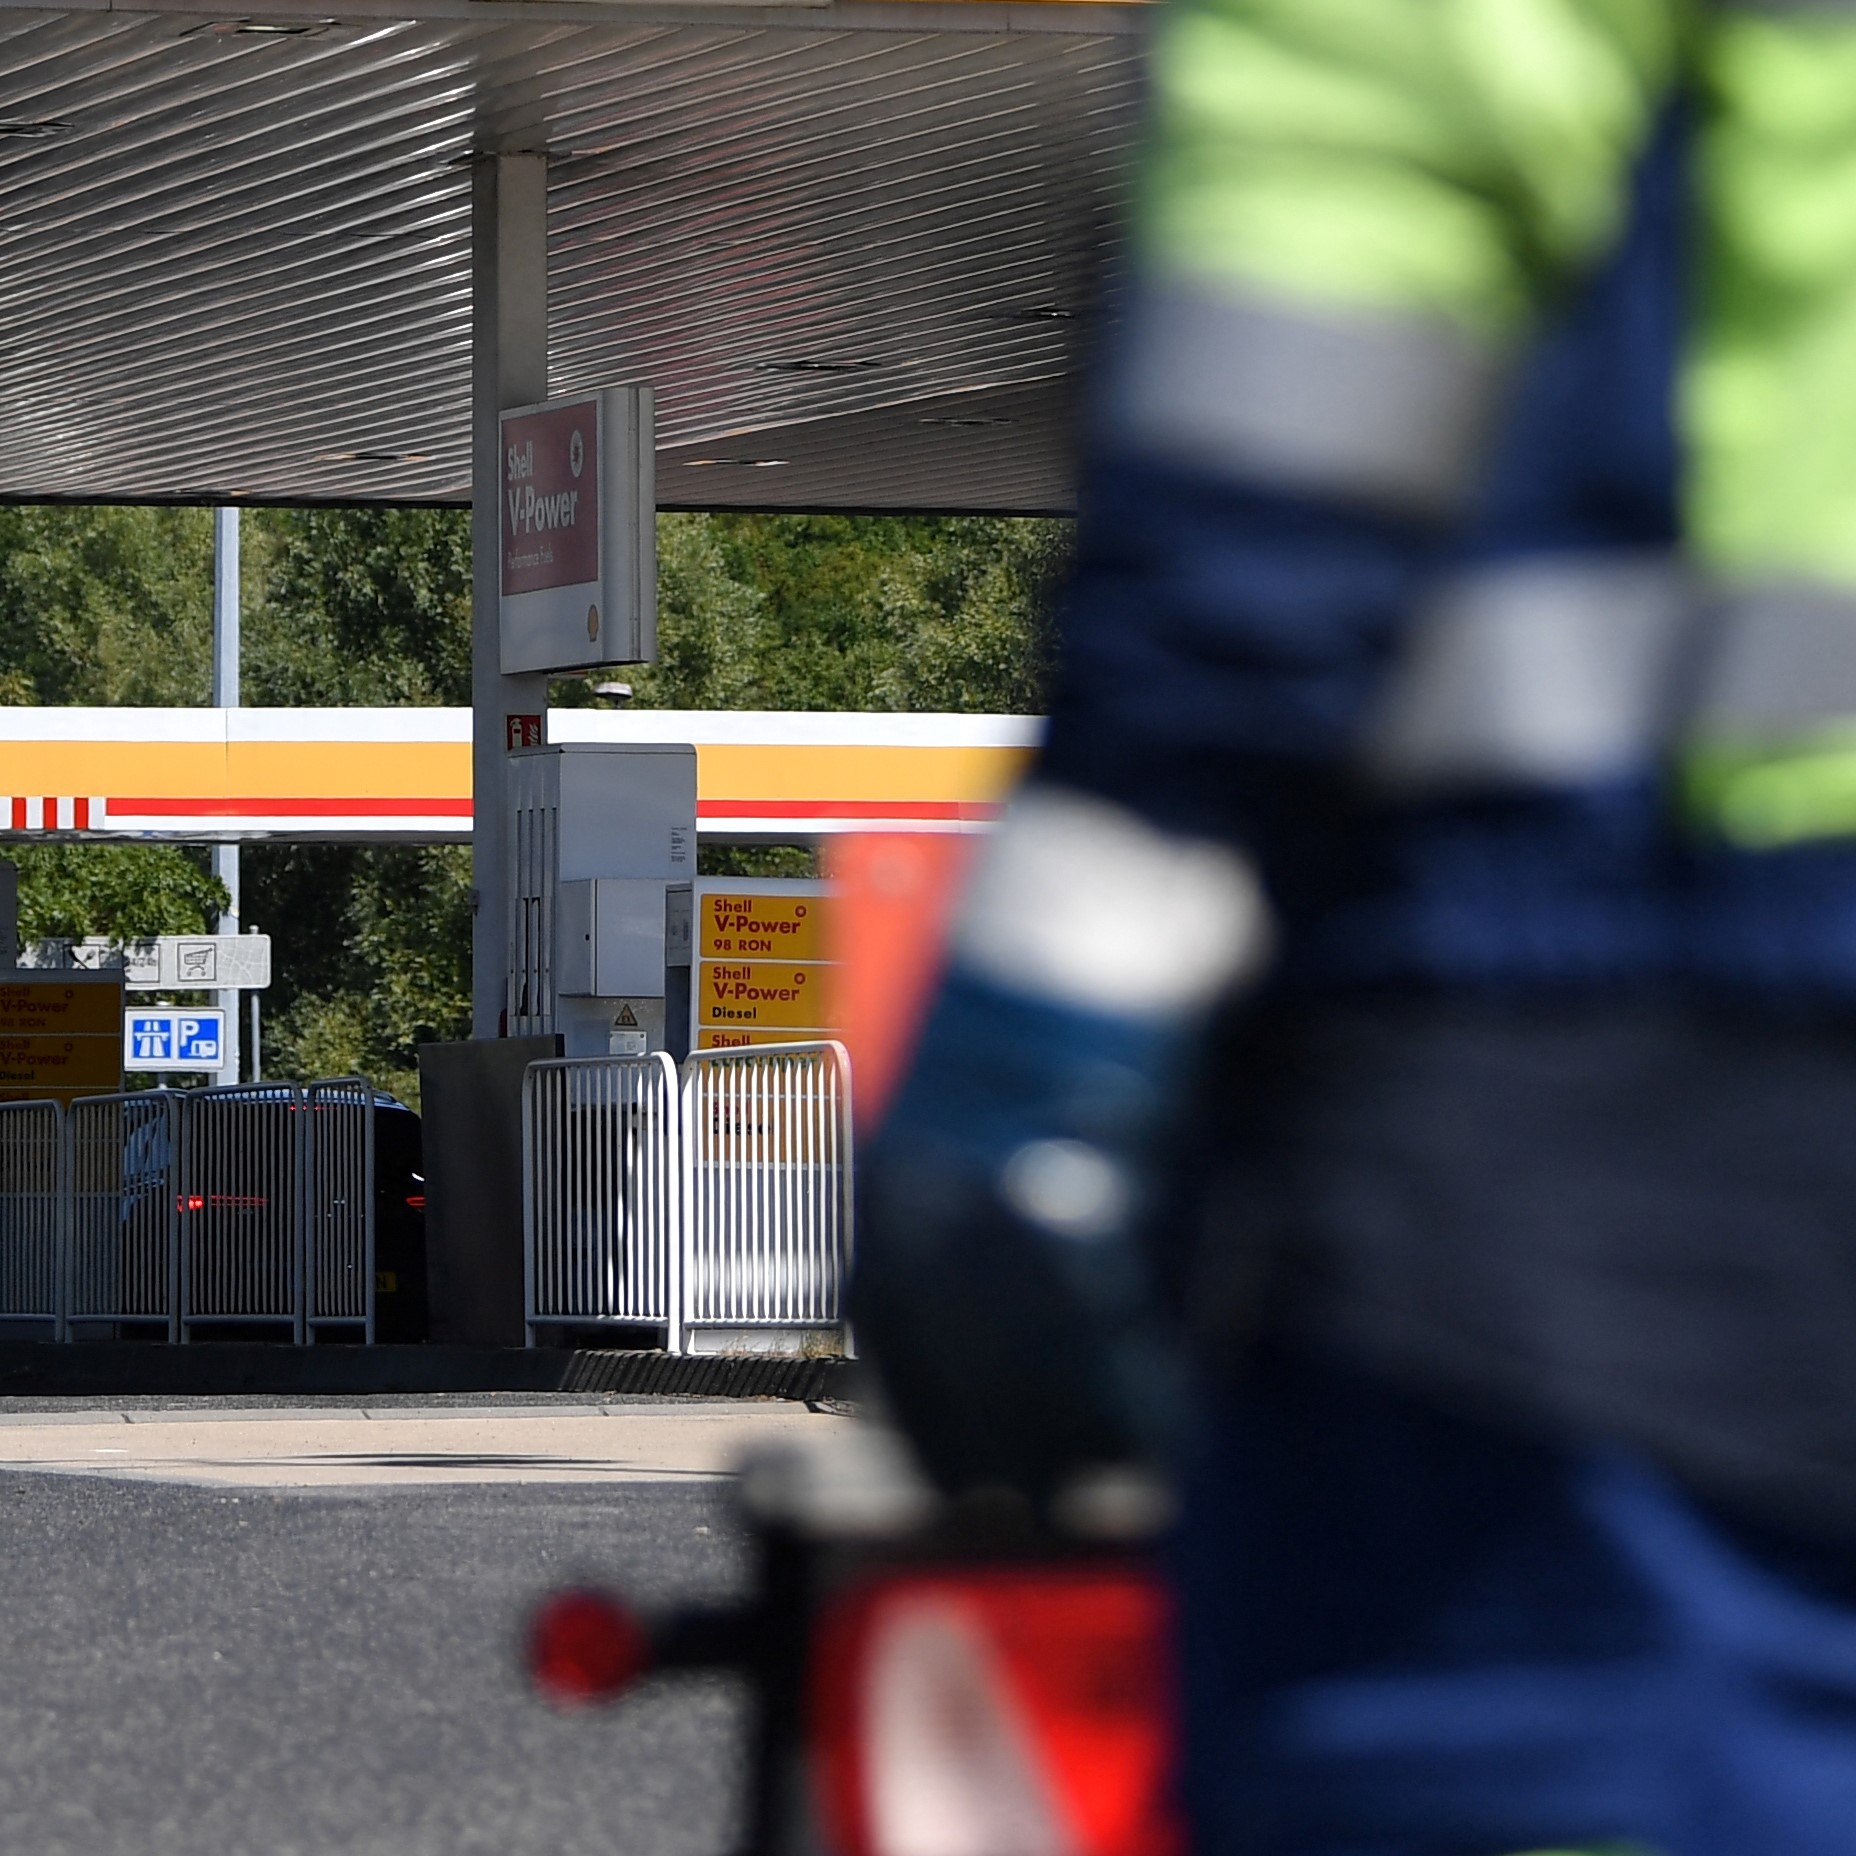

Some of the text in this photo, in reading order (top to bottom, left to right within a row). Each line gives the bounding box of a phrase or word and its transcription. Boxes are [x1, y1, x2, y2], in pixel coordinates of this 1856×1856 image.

[507, 440, 534, 481] Shell
[508, 485, 578, 537] V-Power
[713, 899, 752, 914] Shell
[713, 914, 801, 934] V-Power
[713, 938, 772, 953] 98 RON
[712, 966, 751, 981] Shell
[0, 987, 31, 999] Shell
[712, 981, 800, 1002] V-Power
[0, 999, 70, 1013] V-Power
[711, 1006, 757, 1020] Diesel
[181, 1020, 200, 1047] P
[711, 1034, 751, 1048] Shell
[0, 1039, 31, 1050] Shell
[0, 1051, 70, 1065] V-Power
